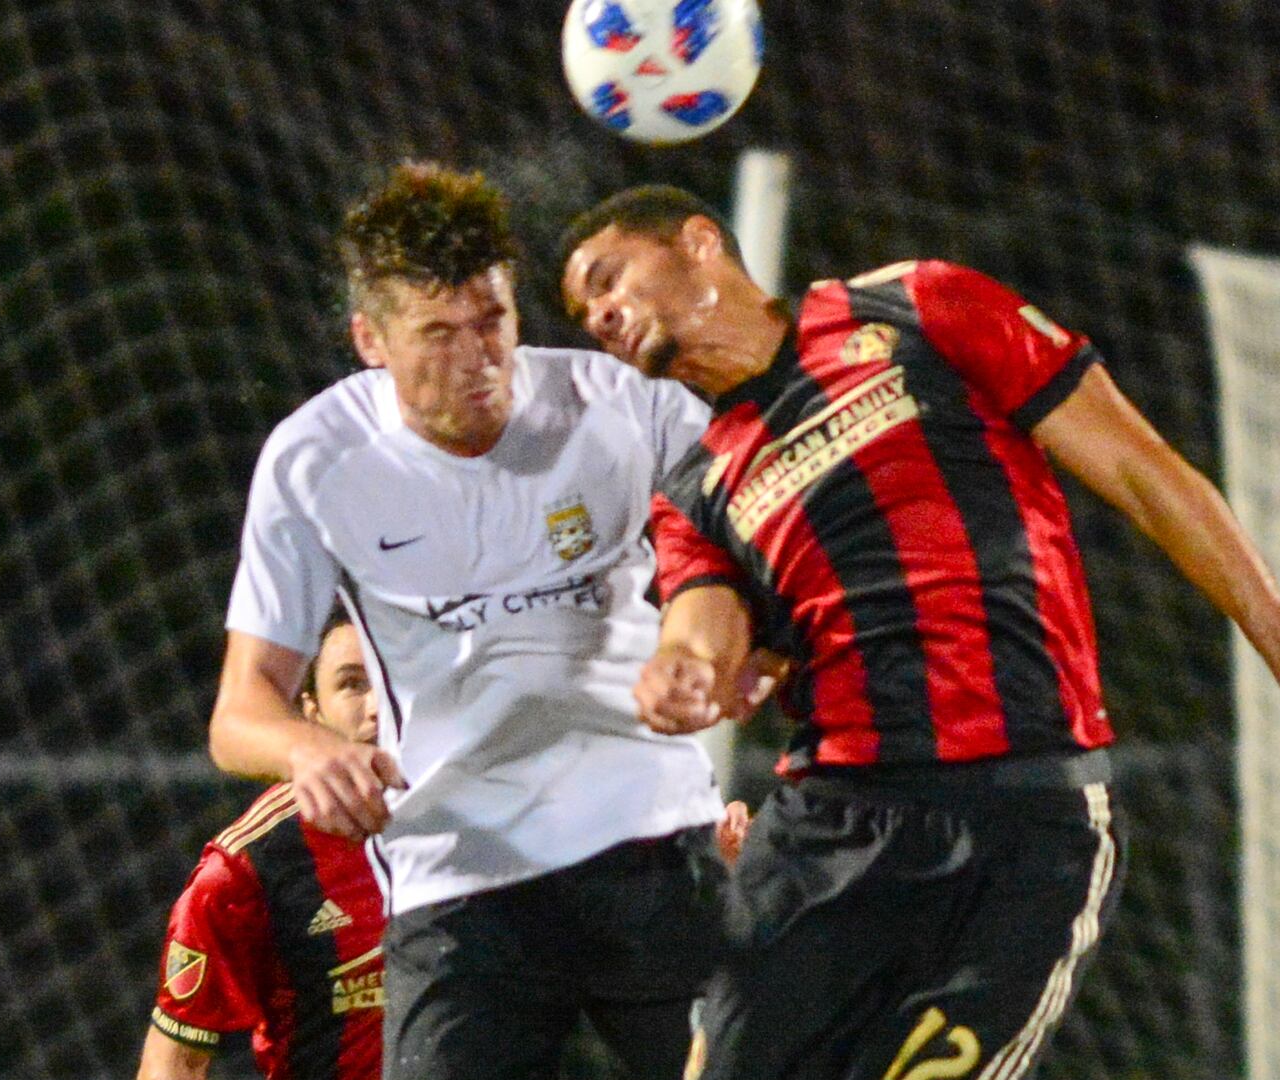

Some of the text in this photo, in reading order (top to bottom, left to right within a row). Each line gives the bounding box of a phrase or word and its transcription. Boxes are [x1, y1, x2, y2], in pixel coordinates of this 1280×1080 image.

[727, 376, 904, 522] AMERICAN FAMILY
[746, 410, 896, 525] INSURANCE
